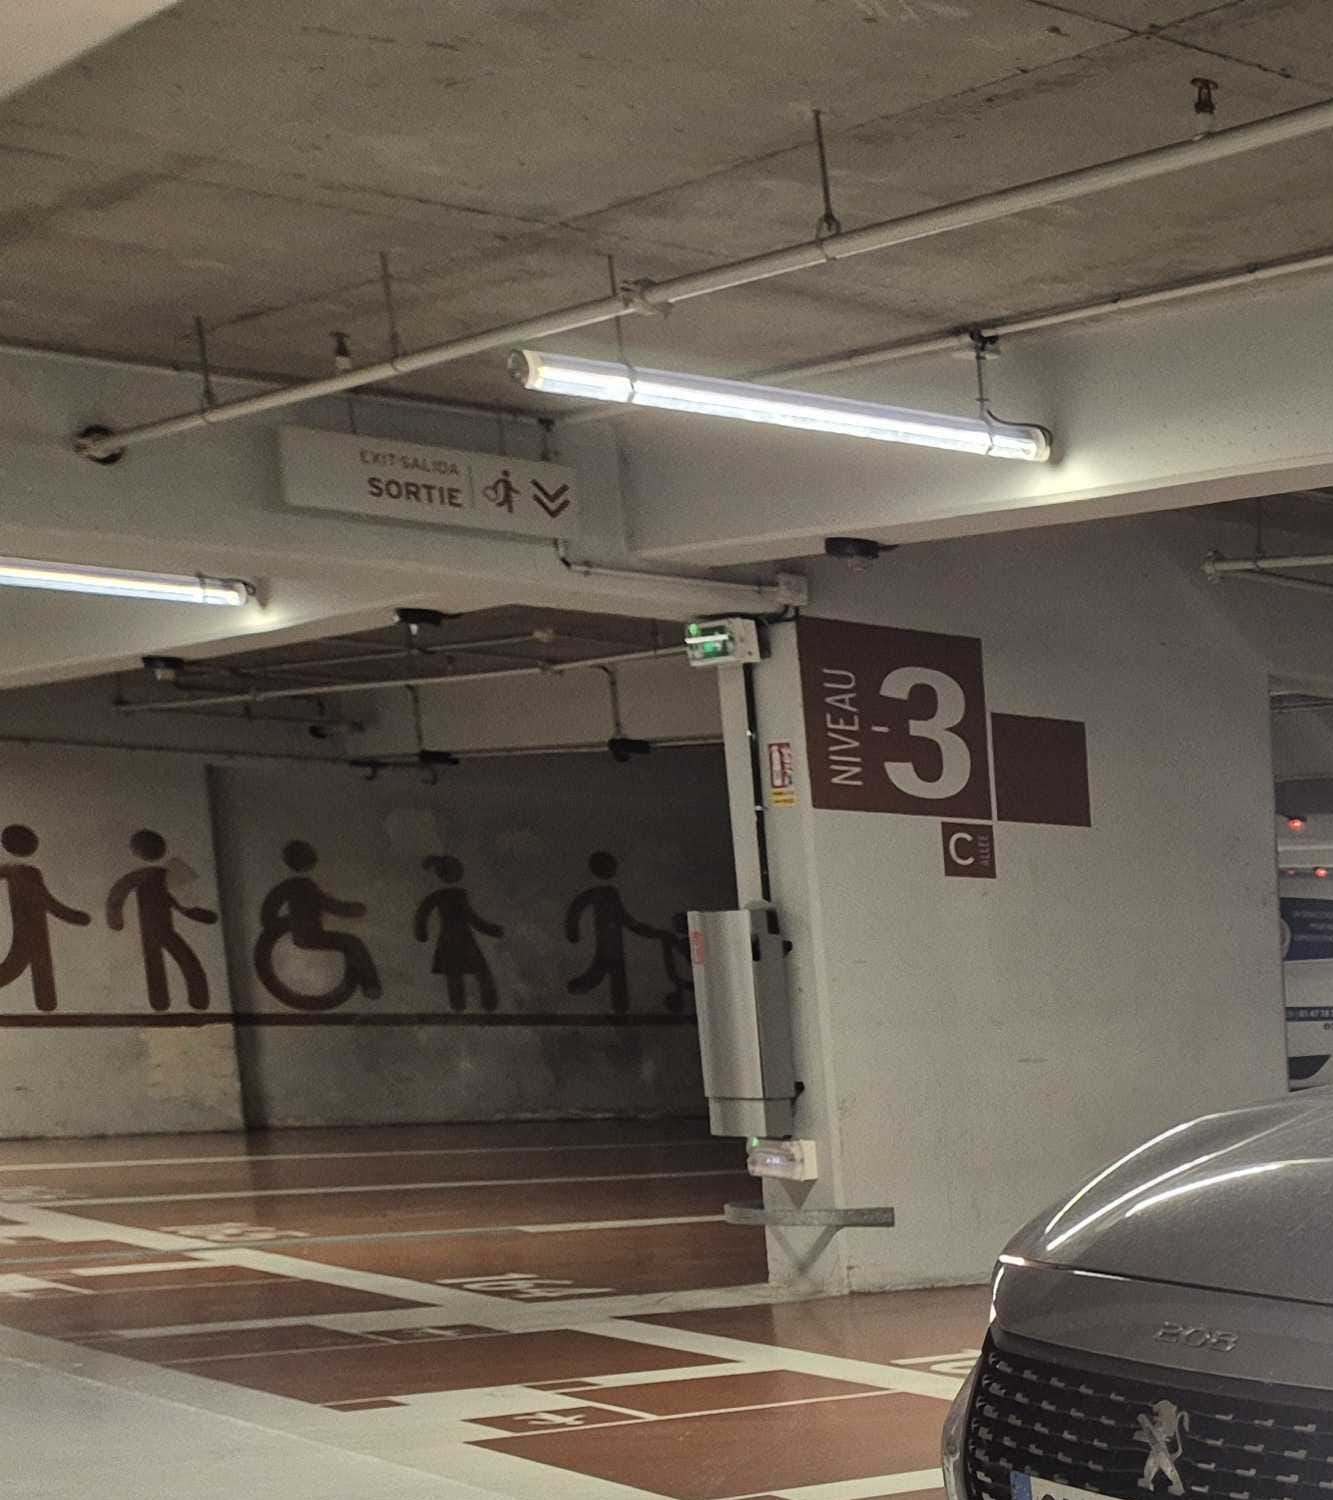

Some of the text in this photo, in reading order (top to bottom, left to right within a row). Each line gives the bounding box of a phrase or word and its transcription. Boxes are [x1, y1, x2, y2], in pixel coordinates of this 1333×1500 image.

[368, 476, 463, 509] SORTIE
[823, 667, 864, 787] NIVEAU
[949, 831, 976, 866] C
[1152, 1321, 1239, 1352] 208
